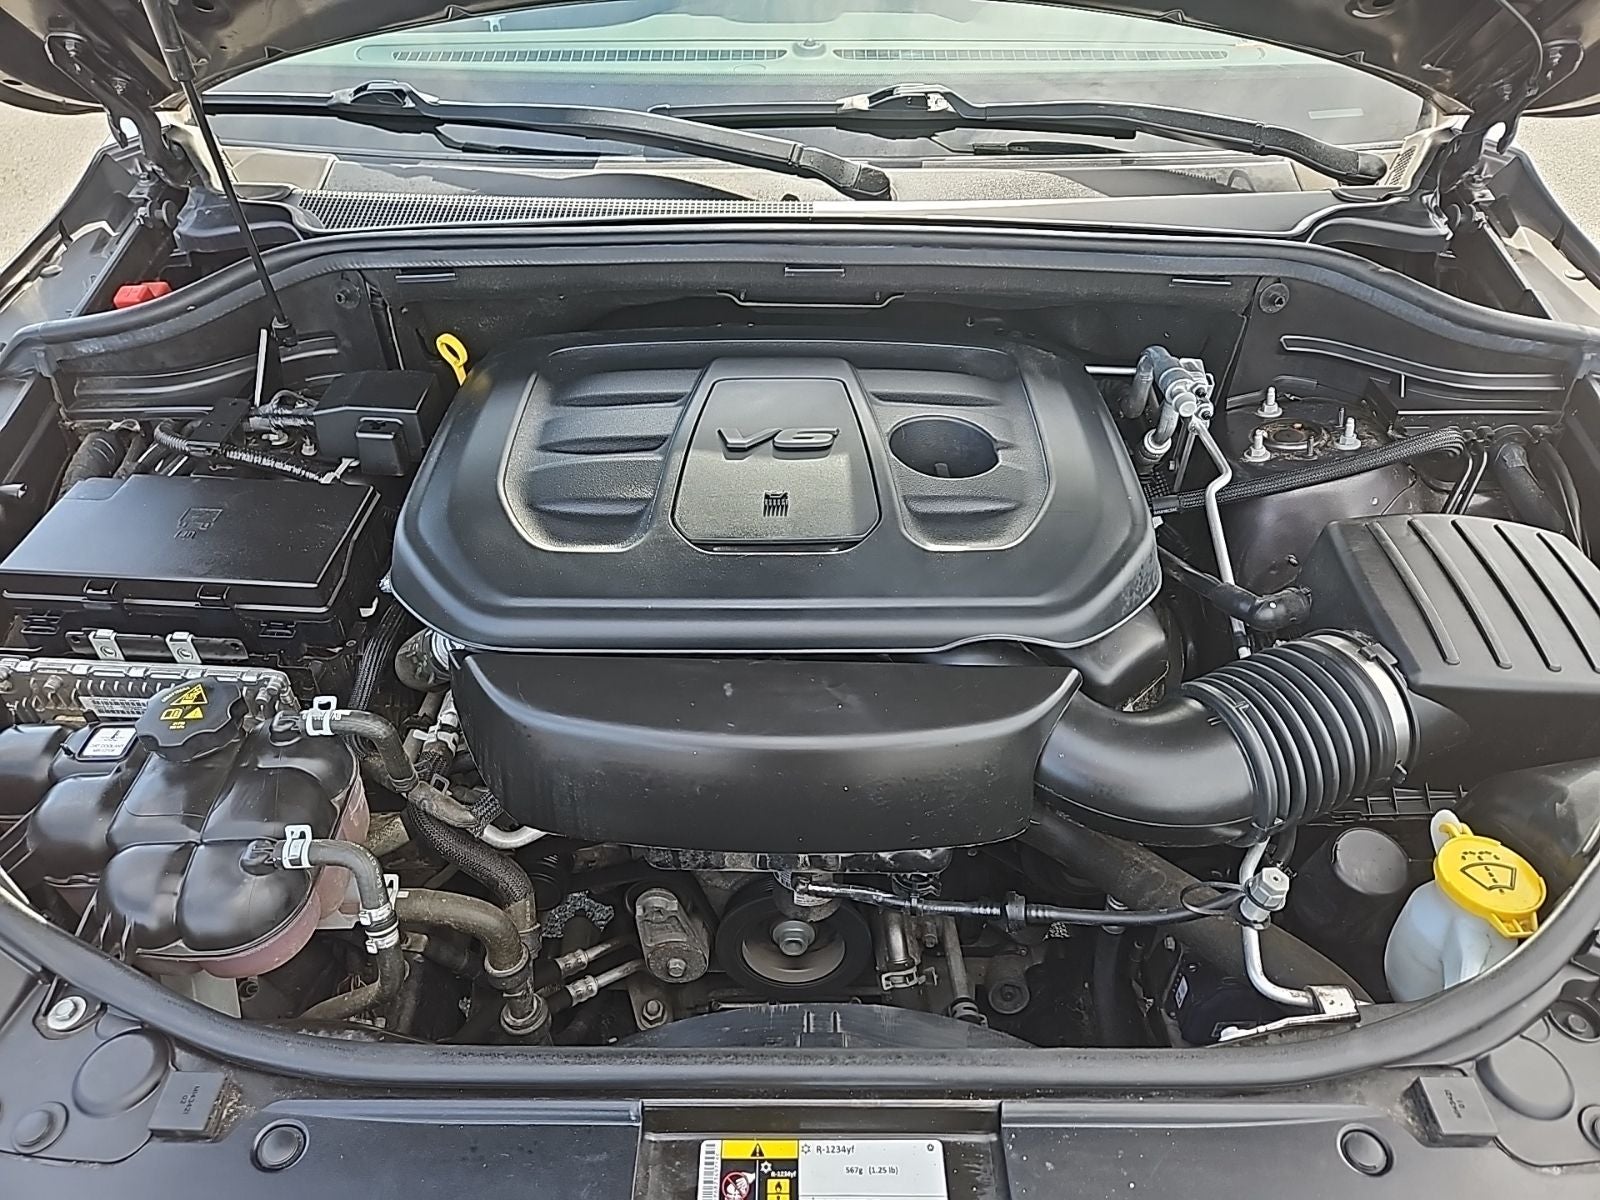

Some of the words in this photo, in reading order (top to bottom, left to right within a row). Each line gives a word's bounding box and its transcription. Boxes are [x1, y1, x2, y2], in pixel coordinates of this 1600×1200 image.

[716, 427, 841, 451] V6
[816, 1145, 856, 1155] R-1234yf
[845, 1166, 863, 1176] 567g
[868, 1166, 888, 1176] (1.25
[888, 1166, 899, 1176] lb)
